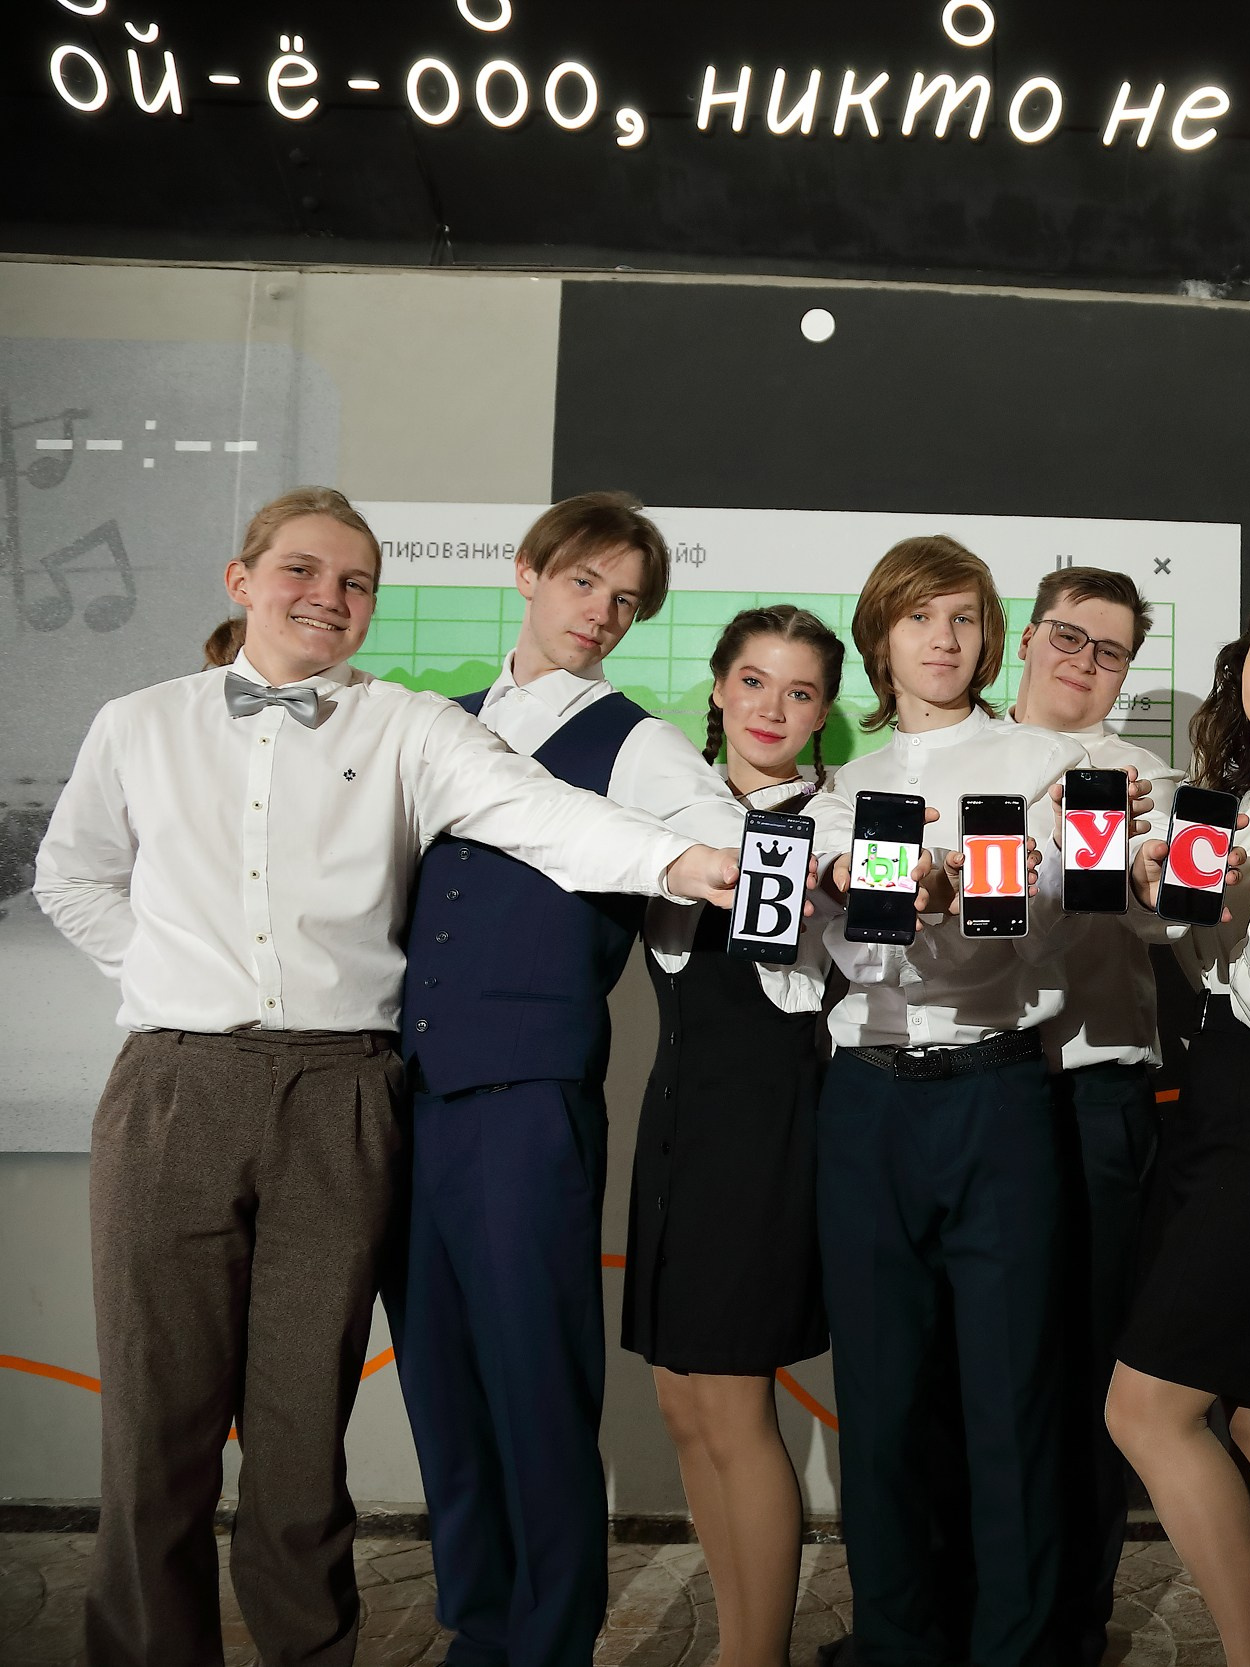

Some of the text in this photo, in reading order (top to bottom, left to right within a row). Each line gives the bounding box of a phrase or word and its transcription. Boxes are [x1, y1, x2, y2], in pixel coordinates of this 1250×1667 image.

[697, 65, 1064, 144] никто
[1102, 81, 1231, 151] не
[380, 540, 516, 563] пирование
[1112, 692, 1152, 711] B/s
[739, 869, 794, 938] В
